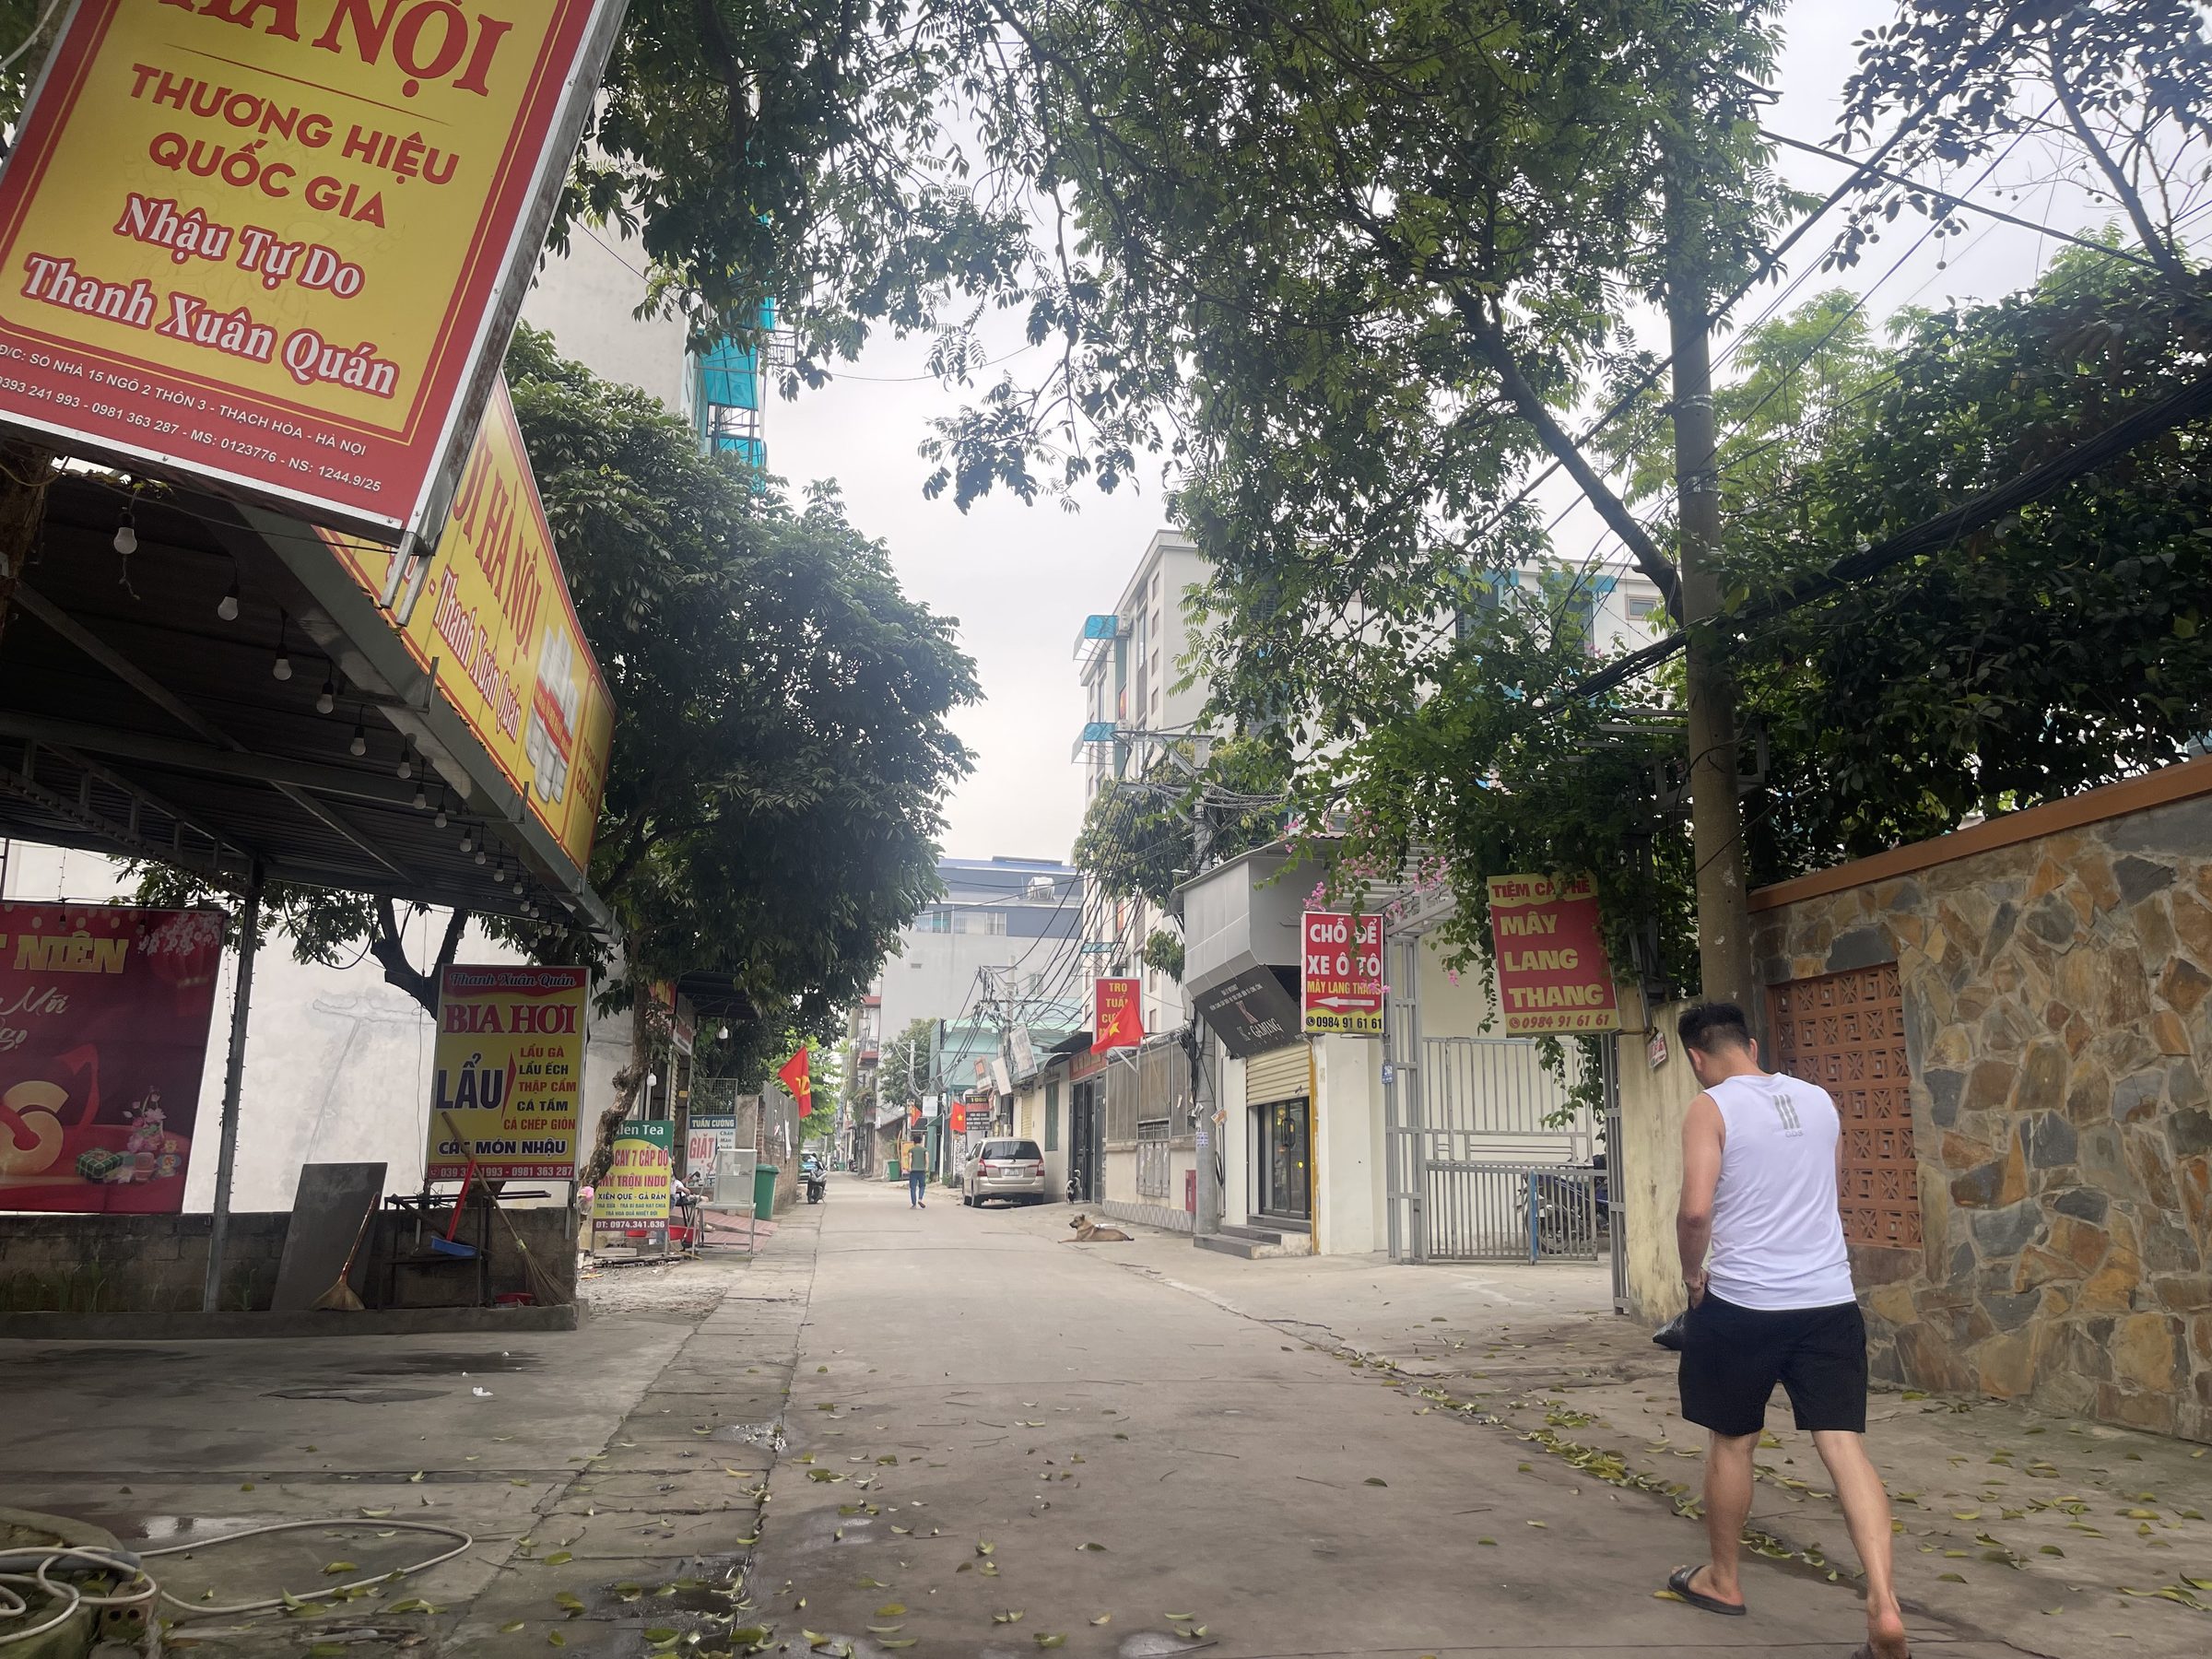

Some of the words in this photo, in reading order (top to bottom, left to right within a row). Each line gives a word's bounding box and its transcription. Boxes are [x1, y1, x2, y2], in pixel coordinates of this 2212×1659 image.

[130, 64, 333, 148] THƯƠNG
[342, 124, 460, 184] HIỆU
[149, 132, 294, 197] QUỐC
[305, 176, 385, 229] GIA
[117, 194, 230, 262] Nhậu
[237, 228, 301, 289] Tự
[300, 248, 365, 299] Do
[22, 255, 155, 329] Thanh
[161, 292, 276, 363] Xuân
[286, 330, 399, 397] Quán
[53, 359, 83, 377] NHÀ
[88, 370, 104, 382] 15
[106, 373, 139, 394] NGÕ
[141, 383, 151, 396] 2
[155, 387, 195, 407] THÔN
[197, 399, 206, 411] 3
[219, 405, 269, 430] THẠCH
[272, 418, 302, 439] HÒA
[315, 431, 336, 448] HÀ
[29, 385, 52, 400] 241
[55, 393, 80, 407] 993
[91, 402, 123, 419] 0981
[126, 411, 151, 427] 363
[155, 419, 180, 435] 287
[190, 429, 217, 446] MS:
[220, 438, 276, 463] 0123776
[288, 456, 314, 473] NS:
[318, 465, 382, 492] 1244.9/25
[476, 467, 518, 604] HÀ
[503, 531, 542, 665] NỘI
[432, 564, 477, 671] Thanh
[468, 624, 500, 710] Xuân
[496, 670, 522, 745] Quán
[1491, 880, 1530, 900] TIỆM
[1310, 917, 1347, 944] CHỖ
[1500, 911, 1558, 936] MÂY
[13, 929, 129, 974] NIÊN
[1503, 947, 1579, 972] LANG
[1307, 955, 1330, 975] XE
[1335, 951, 1350, 976] Ô
[1356, 952, 1381, 977] TÔ
[450, 972, 495, 987] Thanh
[498, 972, 536, 987] Xuân
[538, 972, 576, 988] Quán
[1109, 982, 1128, 994] TRỌ
[1307, 979, 1325, 994] MÂY
[1328, 982, 1350, 994] LANG
[1106, 995, 1129, 1008] TUẤ
[1507, 983, 1604, 1008] THANG
[442, 1004, 505, 1034] BIA
[508, 1003, 578, 1034] HƠI
[1316, 1017, 1339, 1029] 0984
[1343, 1017, 1353, 1029] 91
[1357, 1018, 1368, 1030] 61
[1371, 1018, 1382, 1030] 61
[1522, 1016, 1553, 1029] 0984
[1558, 1015, 1571, 1028] 91
[1576, 1015, 1590, 1027] 61
[1595, 1014, 1609, 1026] 61
[547, 1045, 564, 1058] GÀ
[545, 1061, 569, 1075] ẾCH
[435, 1053, 504, 1110] LẨU
[518, 1080, 547, 1094] THẬP
[516, 1099, 535, 1112] CÁ
[503, 1117, 517, 1130] CÁ
[521, 1117, 547, 1130] CHÉP
[642, 1124, 664, 1135] Tea
[692, 1117, 711, 1127] TUẤN
[712, 1118, 735, 1127] CƯỜNG
[476, 1137, 516, 1155] MÓN
[522, 1138, 567, 1158] NHẬU
[615, 1149, 630, 1167] CAY
[632, 1149, 637, 1166] 7
[657, 1146, 669, 1171] ĐỘ
[689, 1133, 714, 1163] GIẶT
[441, 1167, 458, 1177] 039
[512, 1166, 533, 1176] 0981
[536, 1166, 553, 1176] 363
[556, 1166, 572, 1176] 287
[618, 1173, 642, 1189] TRỘN
[644, 1175, 667, 1187] INDO
[597, 1191, 615, 1200] XIÊN
[638, 1192, 650, 1200] GÀ
[651, 1192, 666, 1200] RÁN
